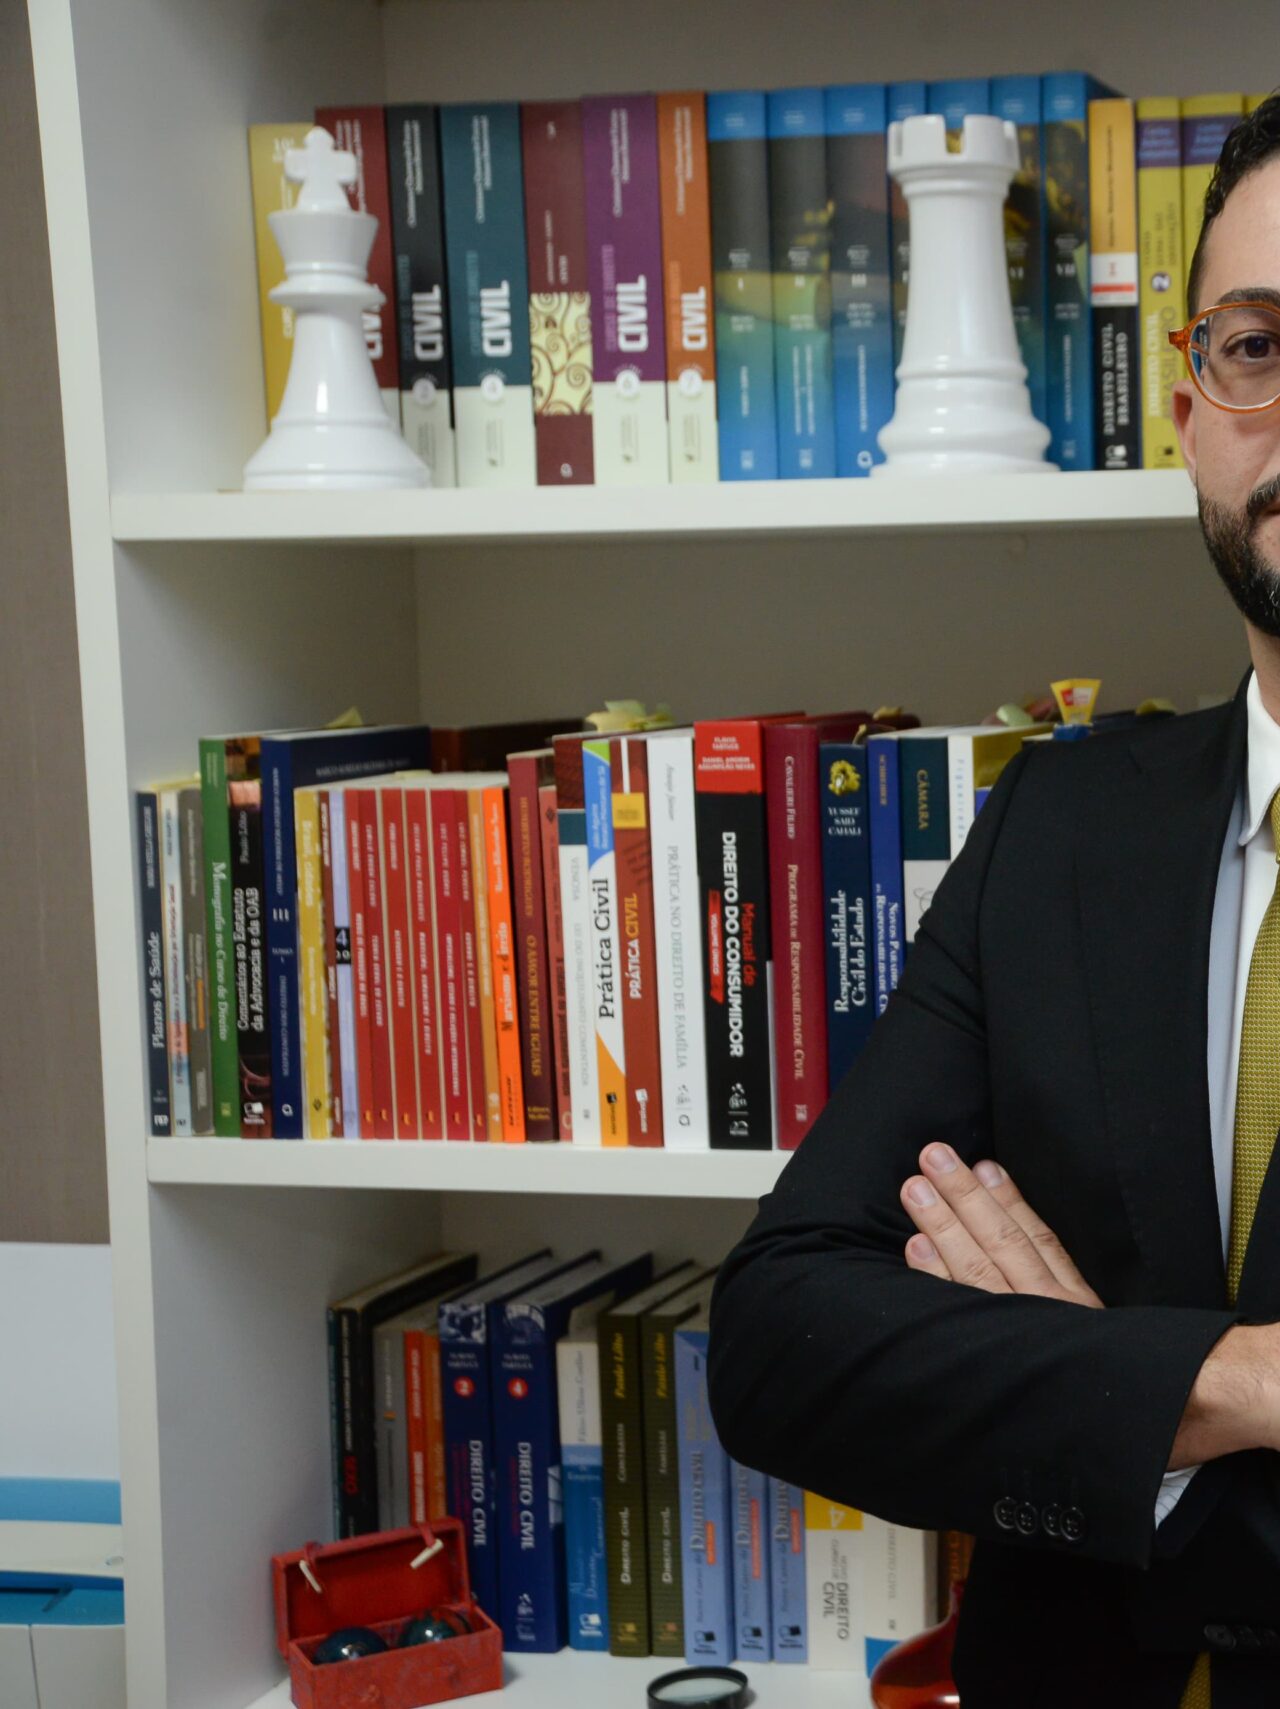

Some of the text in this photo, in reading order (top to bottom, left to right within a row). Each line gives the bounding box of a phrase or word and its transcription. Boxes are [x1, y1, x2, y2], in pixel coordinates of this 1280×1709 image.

[411, 283, 445, 361] CIVIL
[479, 280, 513, 357] CIVIL
[615, 274, 648, 352] CIVIL
[680, 285, 707, 351] CIVIL
[1152, 272, 1172, 294] 2
[1101, 323, 1116, 435] DIREITO CIVIL
[1114, 331, 1130, 425] BRASILEIRO
[785, 756, 797, 839] CAVALIERI FILHO
[827, 807, 860, 817] YUSSEF
[828, 827, 862, 837] CAHALI
[916, 769, 931, 830] CÂMARA
[272, 907, 290, 922] III
[570, 857, 580, 902] VENOSA
[787, 864, 799, 927] PROGRAMA
[212, 862, 229, 1041] Monografia no Curso de Direito
[232, 887, 249, 1031] Comentários ao Estatuto
[245, 887, 264, 1031] da Advocacia e da OAB
[592, 878, 615, 1019] Prática Civil
[624, 893, 641, 999] PRÁTICA CIVIL
[668, 845, 690, 1069] PRÁTICA NO DIREITO DE FAMÍLIA
[710, 912, 720, 946] VOLUME
[722, 831, 745, 1058] DIREITO DO CONSUMIDOR
[741, 903, 758, 987] Manual de
[831, 890, 852, 1012] Responsabilidade
[848, 897, 867, 1006] Civil do Estado
[147, 931, 166, 1049] Planos de Saúde
[527, 934, 542, 1077] O AMOR ENTRE IGUAIS
[790, 941, 803, 1047] RESPONSABILIDADE
[794, 1048, 805, 1081] CIVIL
[612, 1333, 626, 1398] Paulo Lôbo
[655, 1332, 668, 1398] Paulo Lôbo
[469, 1440, 488, 1547] DIREITO CIVIL
[518, 1442, 536, 1551] DIREITO CIVIL
[618, 1507, 632, 1584] DIREITO CIVIL
[659, 1507, 673, 1584] DIREITO CIVIL
[823, 1581, 836, 1620] CIVIL
[836, 1581, 850, 1641] DIREITO
